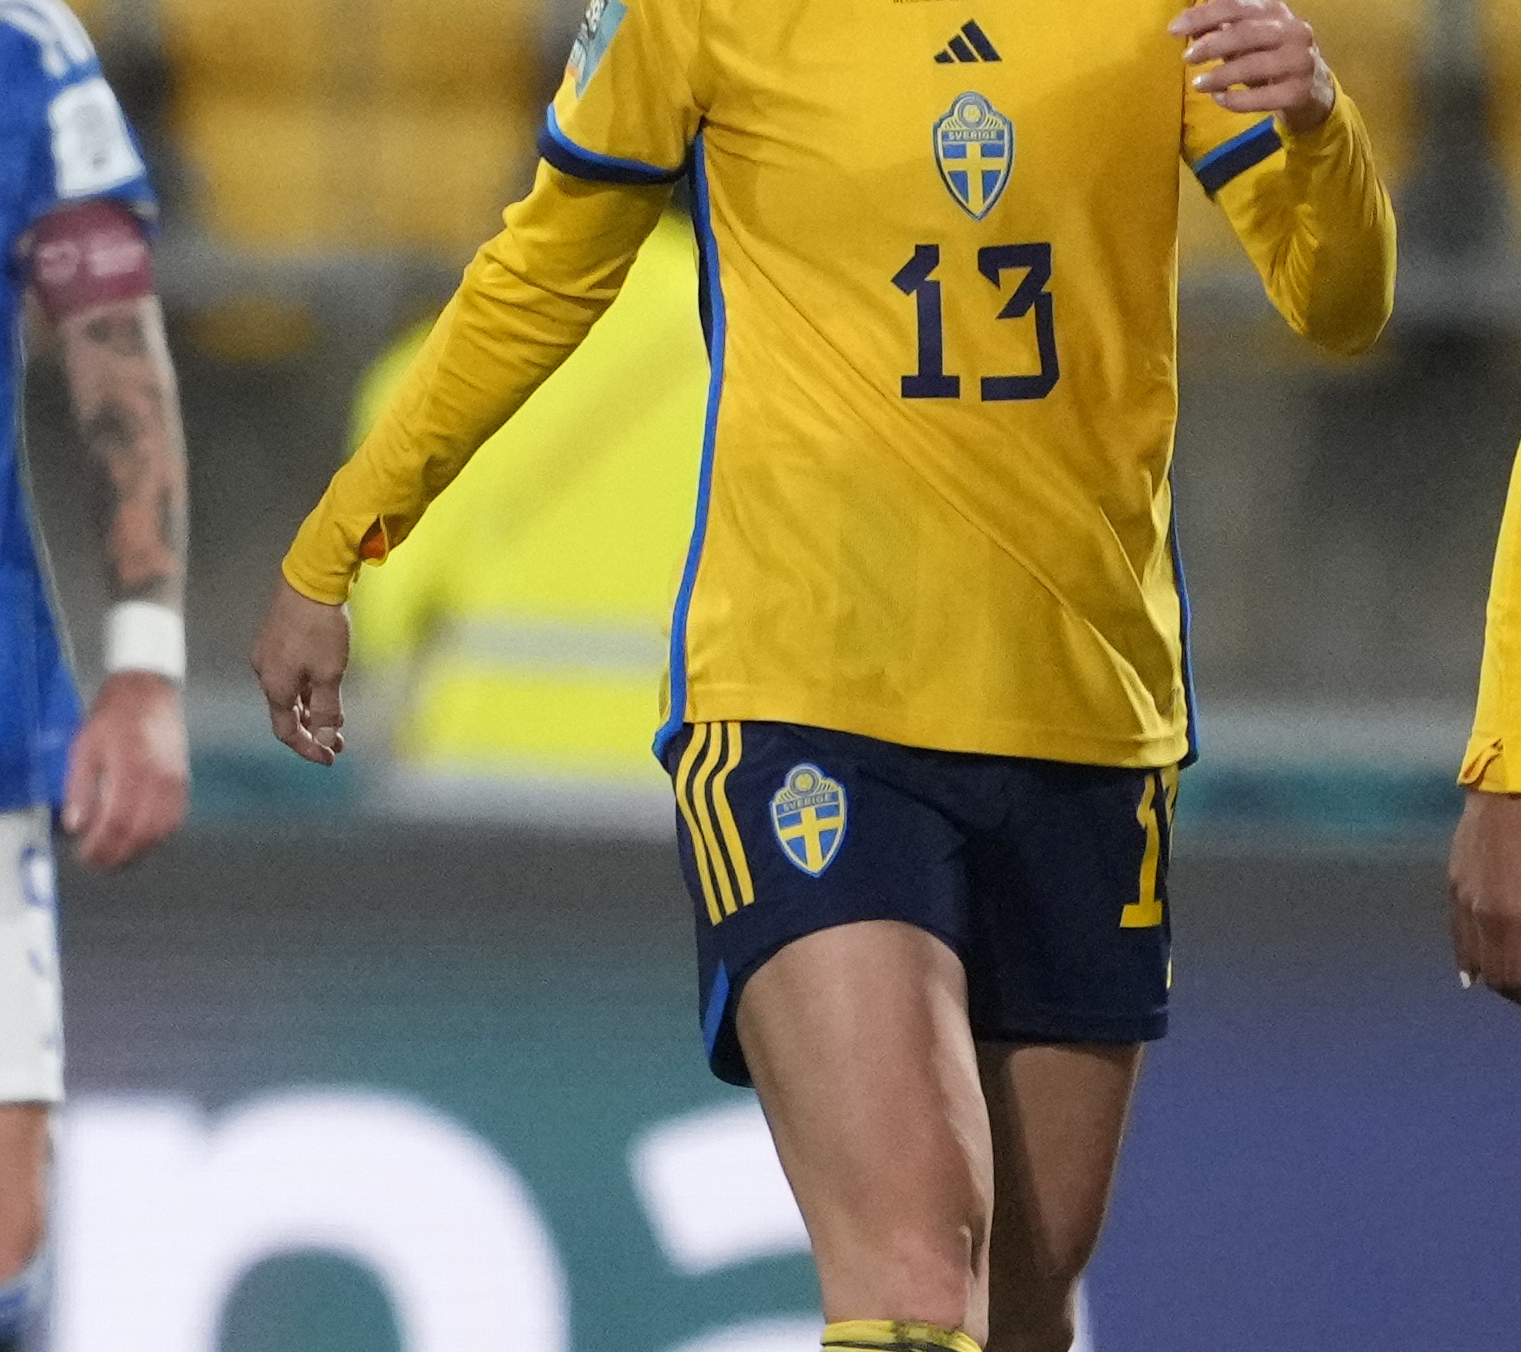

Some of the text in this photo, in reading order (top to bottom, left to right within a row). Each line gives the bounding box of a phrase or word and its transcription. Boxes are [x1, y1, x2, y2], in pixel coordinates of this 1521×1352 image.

[948, 129, 998, 141] SVERIGE
[891, 242, 1060, 402] 13
[1119, 775, 1164, 929] 1
